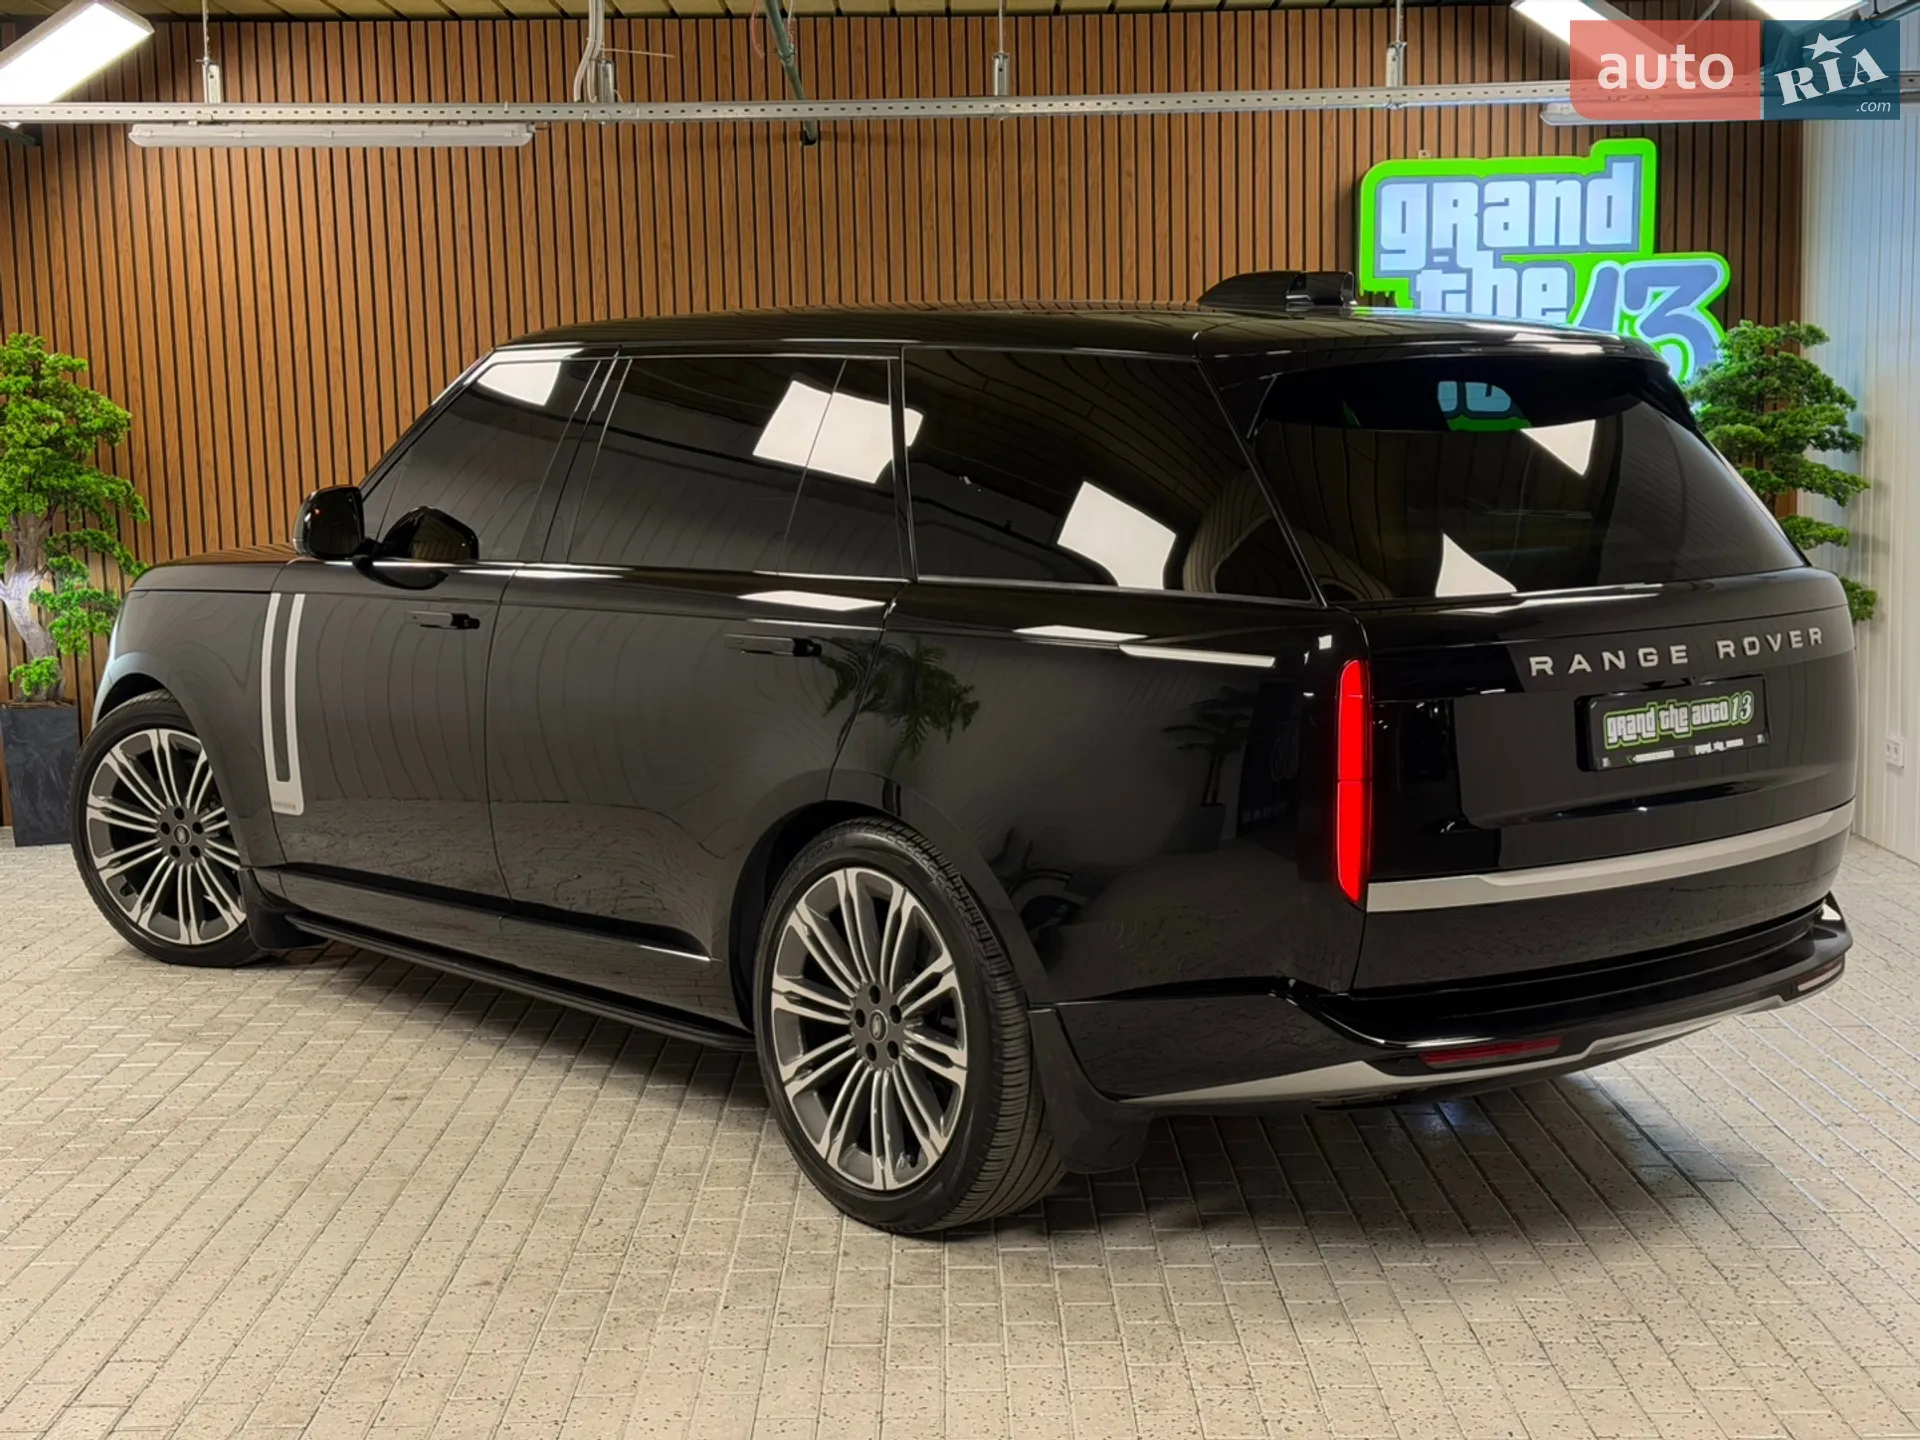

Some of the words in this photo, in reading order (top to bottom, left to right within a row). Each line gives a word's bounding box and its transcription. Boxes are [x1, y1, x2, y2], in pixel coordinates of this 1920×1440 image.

[1529, 644, 1689, 677] RANGE
[1716, 626, 1823, 660] ROVER
[1658, 703, 1690, 734] the
[1691, 701, 1729, 726] auto
[1730, 694, 1752, 722] 13
